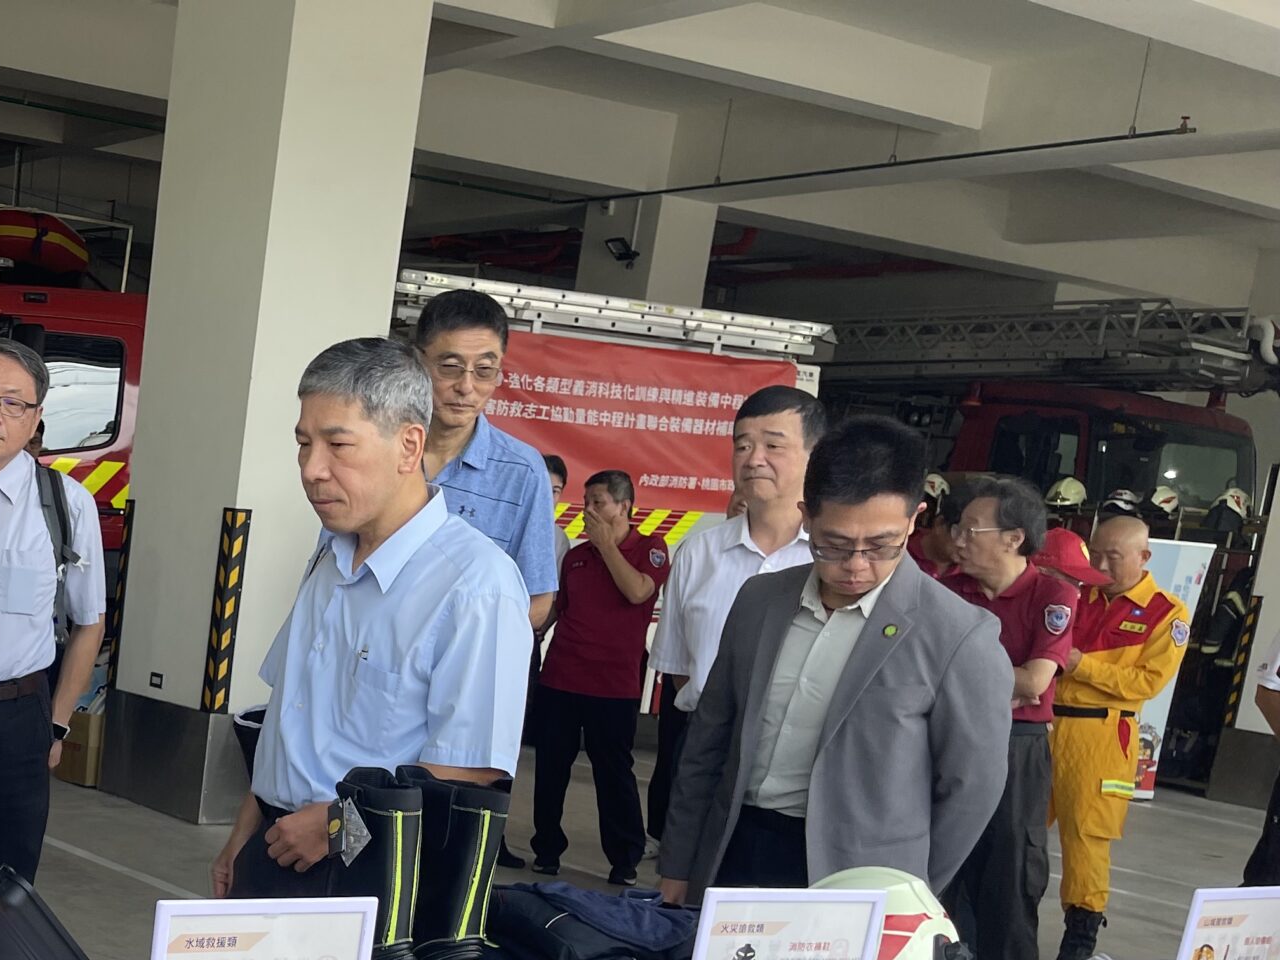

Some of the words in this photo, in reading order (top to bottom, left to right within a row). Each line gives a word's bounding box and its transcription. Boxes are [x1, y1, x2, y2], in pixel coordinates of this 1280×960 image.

[504, 372, 748, 410] -強化各類型義消科技化訓練與精進裝備中程
[184, 936, 238, 949] 水域救援類
